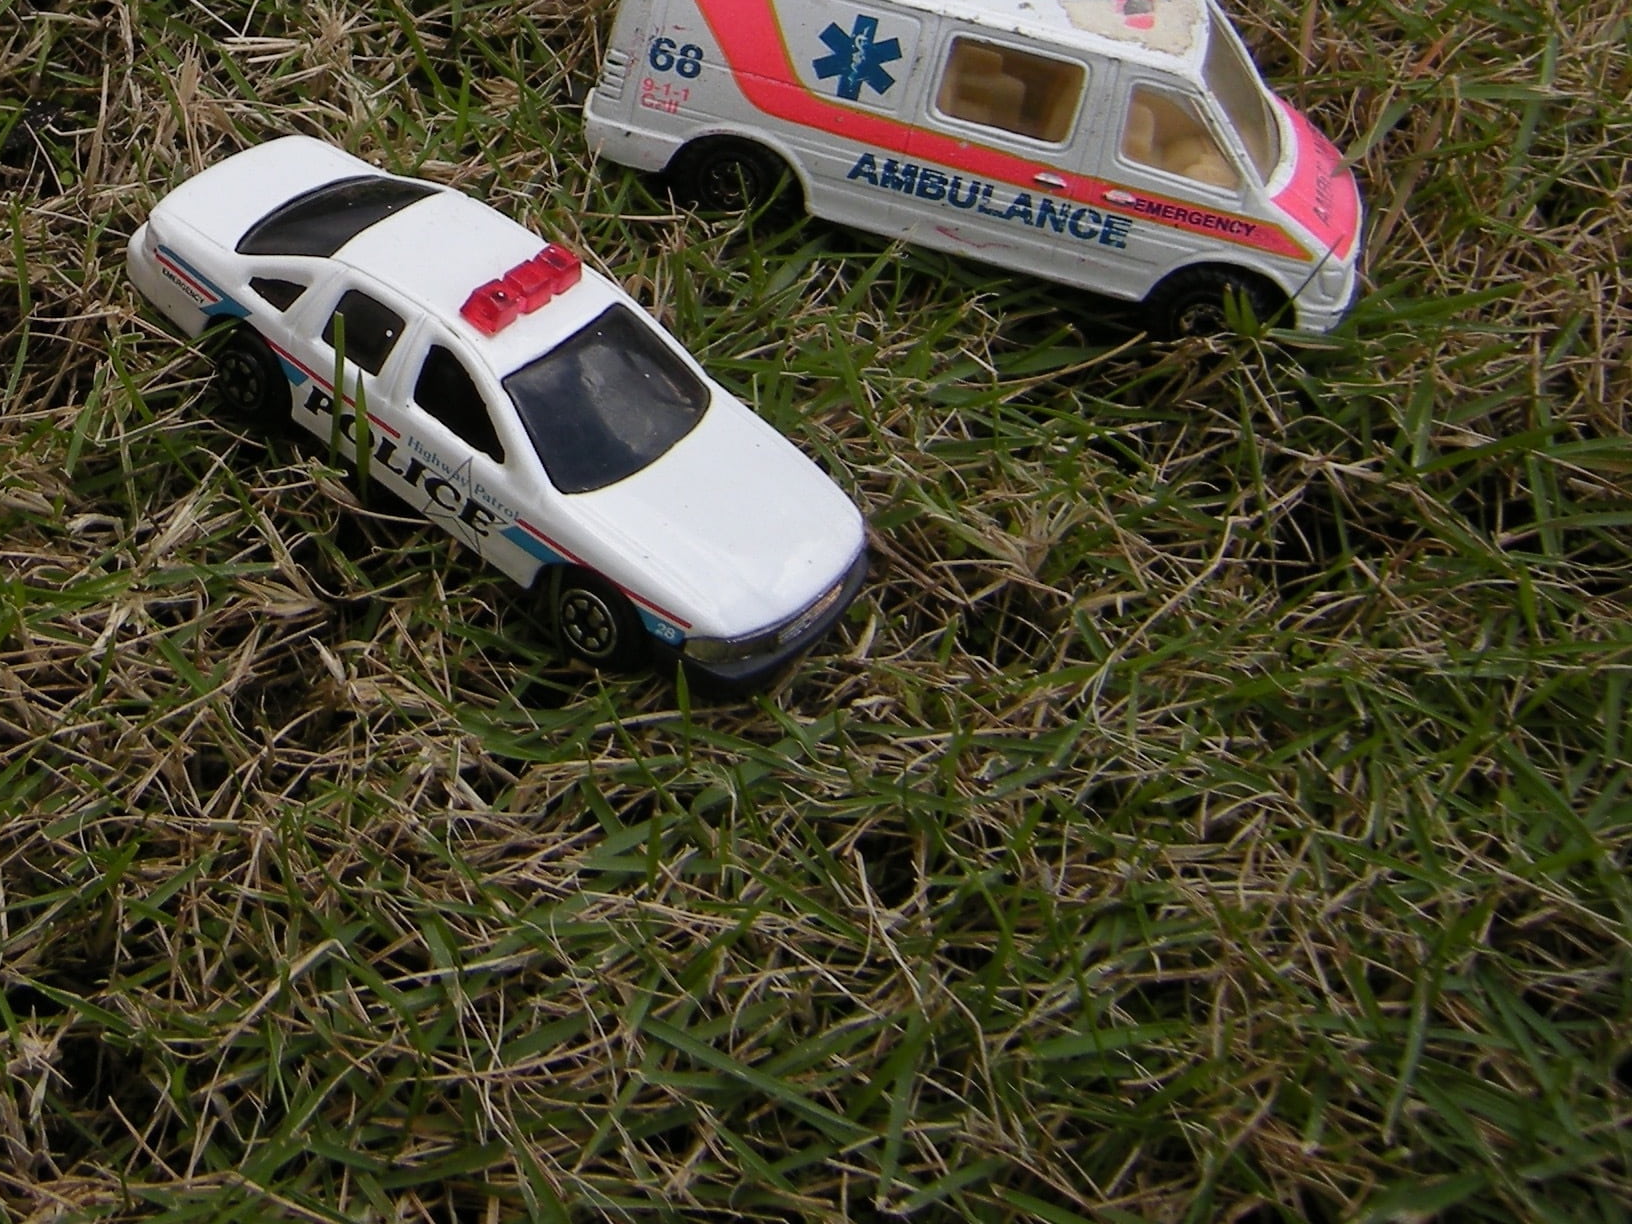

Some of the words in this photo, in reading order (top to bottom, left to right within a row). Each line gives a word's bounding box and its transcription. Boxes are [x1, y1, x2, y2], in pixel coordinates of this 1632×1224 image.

[649, 37, 704, 79] 68
[642, 77, 690, 102] 9-1-1
[846, 152, 1134, 250] AMBULANCE
[1132, 197, 1257, 237] EMERGENCY
[303, 385, 497, 537] POLICE
[407, 435, 469, 489] Highway
[473, 482, 520, 521] Patrol
[654, 622, 676, 640] 28
